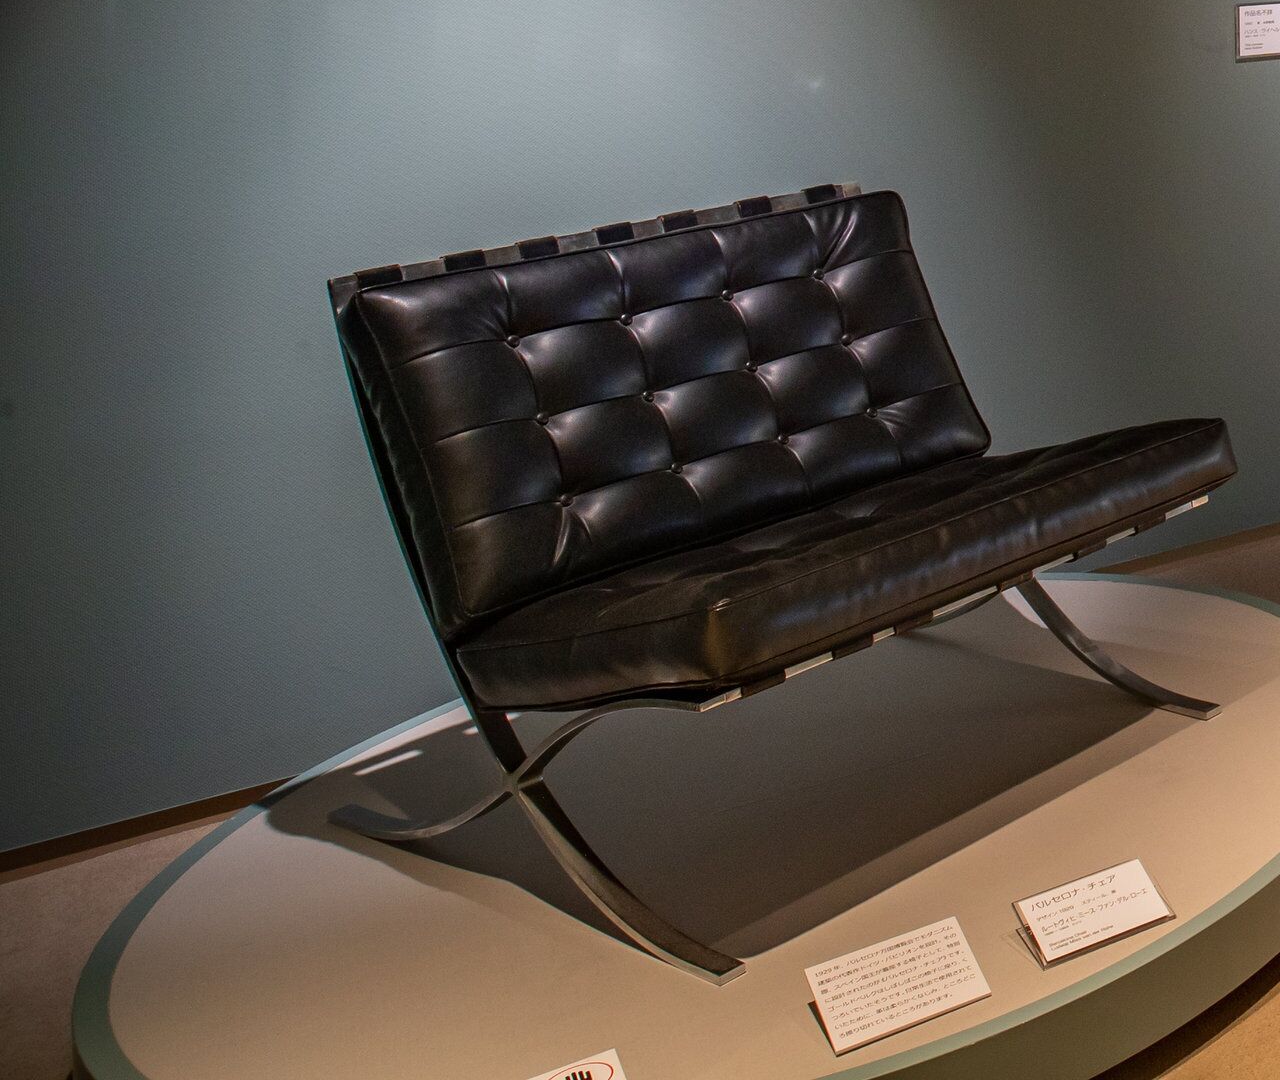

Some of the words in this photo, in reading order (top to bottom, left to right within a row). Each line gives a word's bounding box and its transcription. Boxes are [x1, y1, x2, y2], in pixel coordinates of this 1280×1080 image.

[1031, 874, 1117, 912] バルセロナ・チェア
